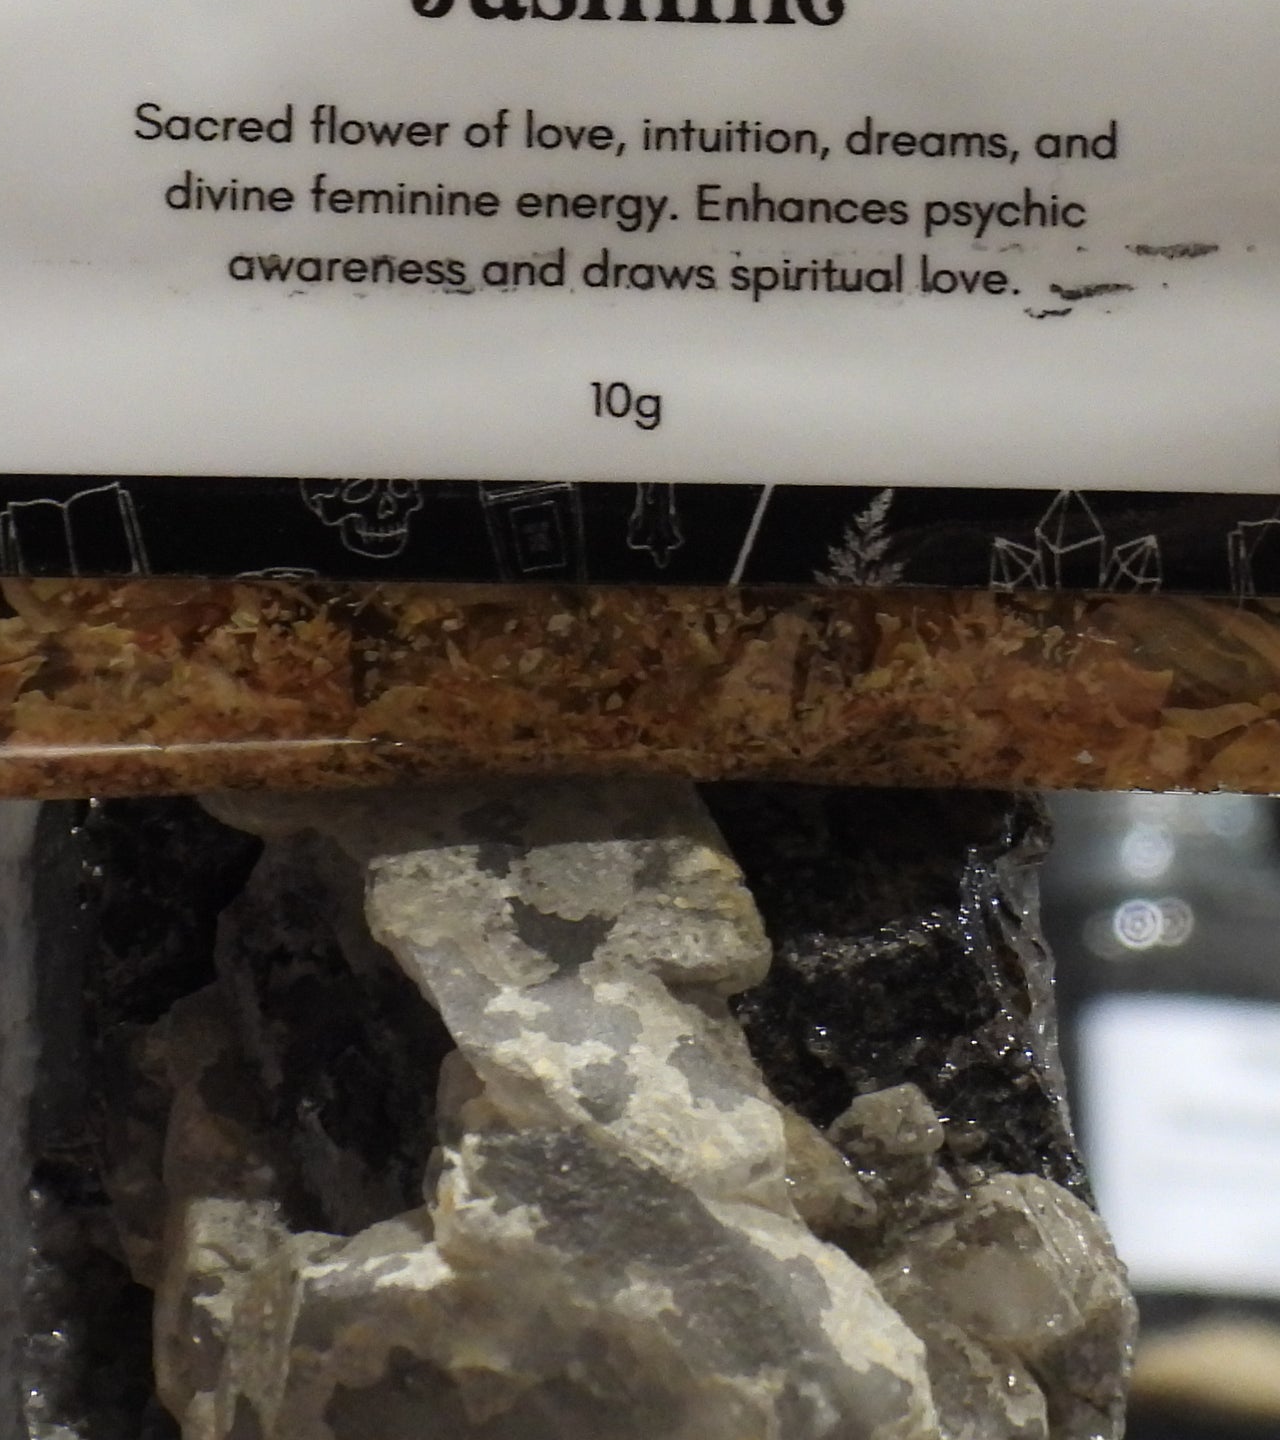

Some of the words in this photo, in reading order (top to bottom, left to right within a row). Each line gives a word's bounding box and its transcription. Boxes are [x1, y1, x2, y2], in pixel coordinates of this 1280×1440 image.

[134, 102, 294, 144] Sacred
[310, 104, 450, 147] flower
[464, 109, 510, 148] of
[526, 109, 626, 157] love,
[643, 119, 830, 161] intuition,
[845, 116, 1019, 165] dreams,
[1035, 119, 1118, 160] and
[164, 170, 295, 212] divine
[310, 173, 501, 217] feminine
[516, 193, 678, 233] energy.
[696, 182, 909, 225] Enhances
[924, 187, 1087, 239] psychic
[226, 251, 466, 285] awareness
[482, 247, 567, 288] and
[582, 248, 717, 291] draws
[730, 253, 903, 303] spiritual
[917, 254, 1020, 295] love.
[591, 382, 662, 430] 10g
